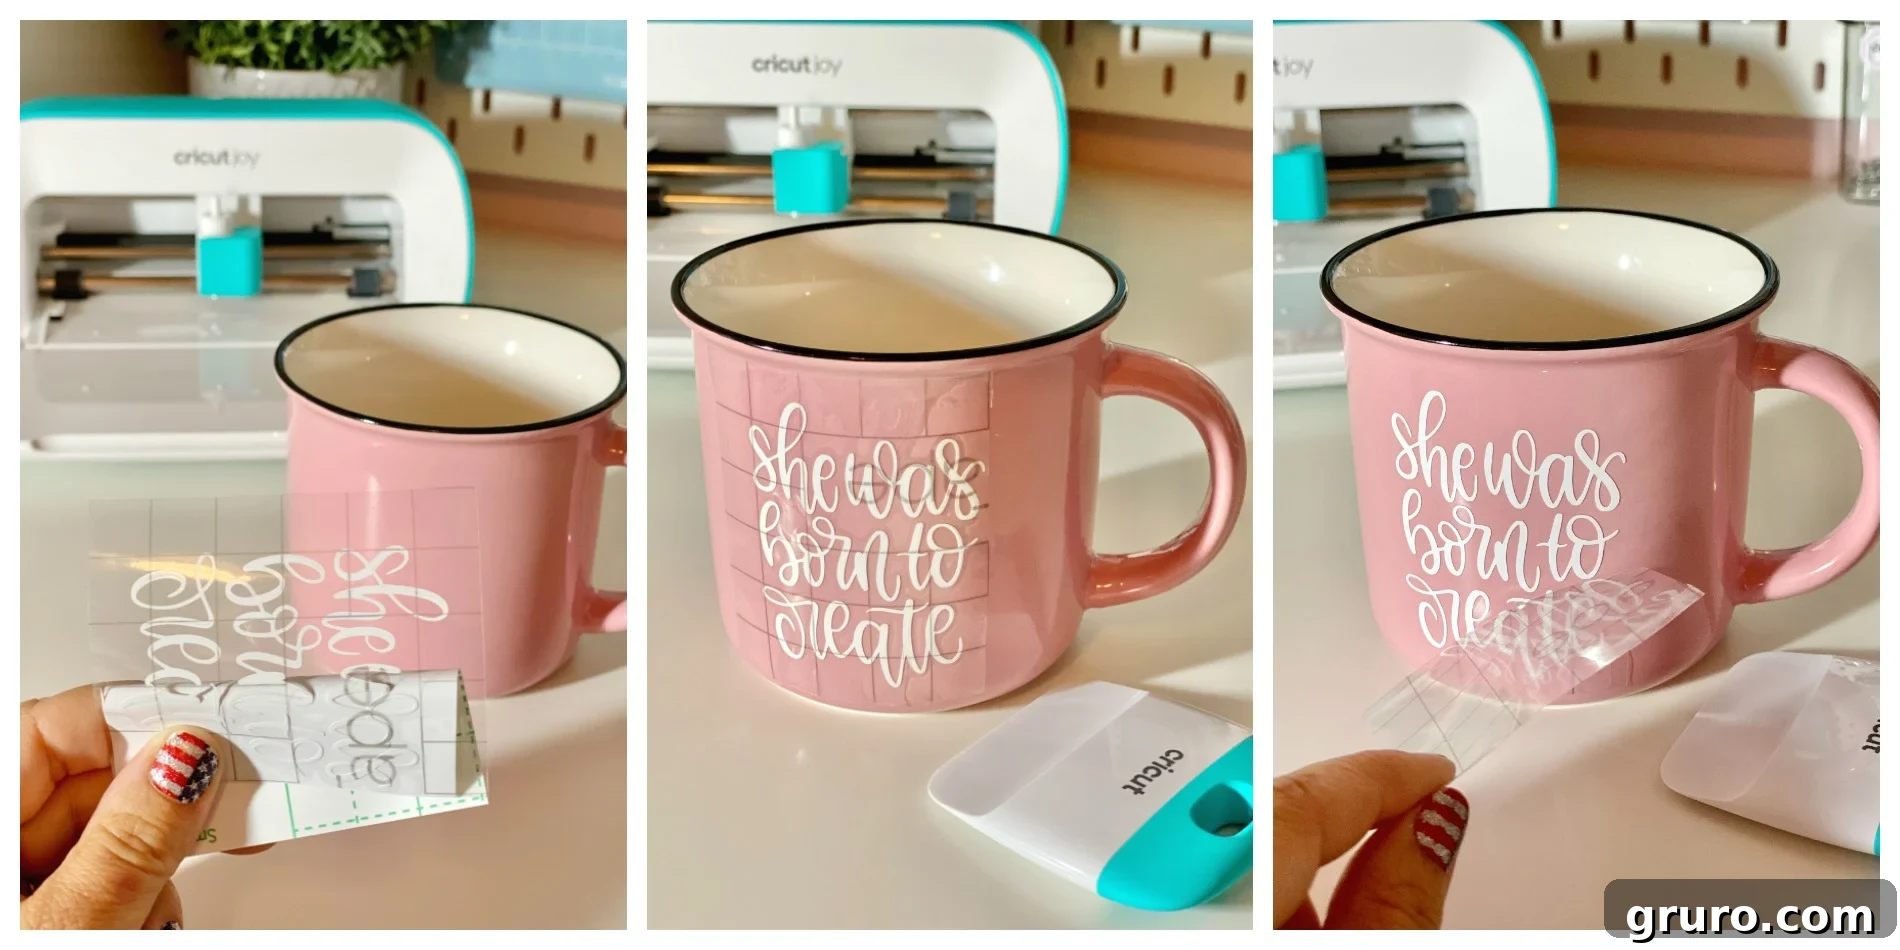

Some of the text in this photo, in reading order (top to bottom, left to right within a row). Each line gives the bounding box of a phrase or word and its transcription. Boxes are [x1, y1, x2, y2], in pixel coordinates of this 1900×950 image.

[751, 53, 843, 79] cricut joy
[1282, 56, 1314, 80] joy
[172, 145, 260, 171] cricut joy
[749, 402, 985, 520] she was
[1392, 390, 1626, 511] she was
[760, 500, 979, 602] born to
[1402, 489, 1619, 592] born to
[763, 586, 962, 688] create
[1121, 749, 1184, 795] cricut
